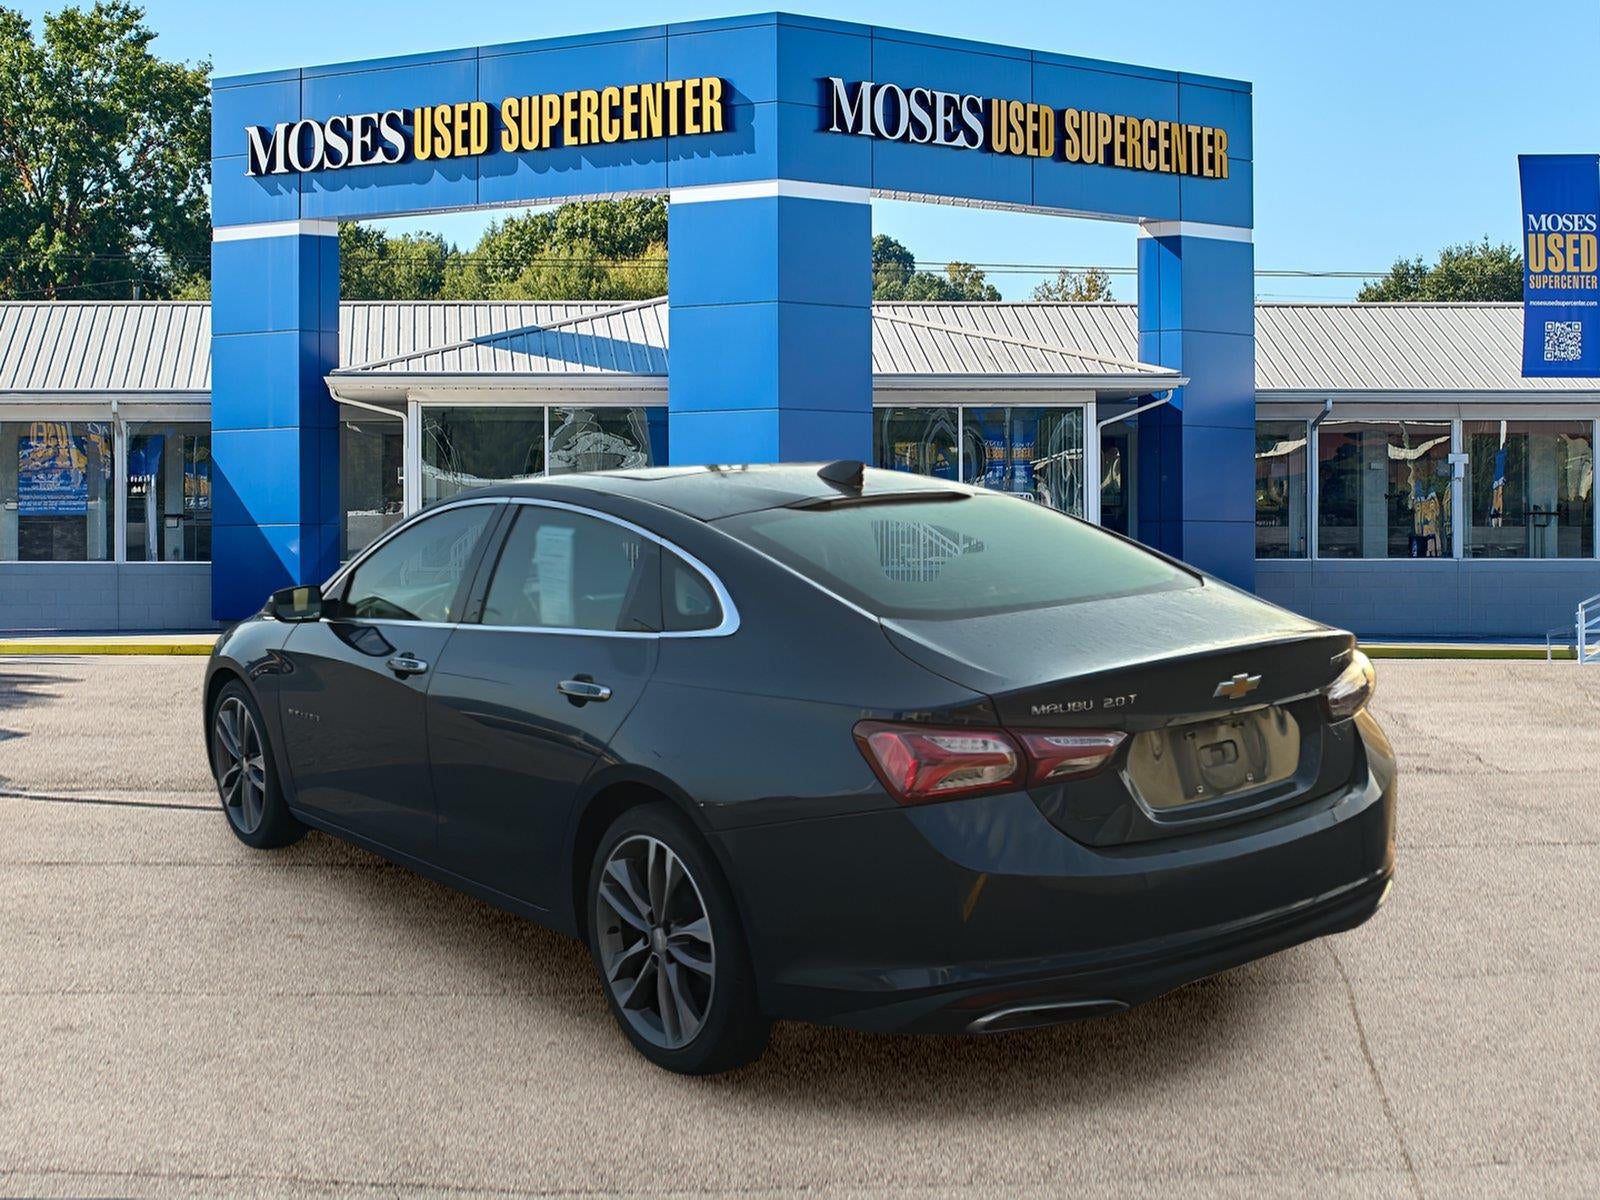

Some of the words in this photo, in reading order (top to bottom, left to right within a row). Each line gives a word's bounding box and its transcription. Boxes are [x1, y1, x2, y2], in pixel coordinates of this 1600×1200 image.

[245, 110, 406, 176] MOSES
[413, 101, 488, 160] USED
[501, 77, 723, 154] SUPERCENTER
[829, 77, 984, 149] MOSES
[991, 98, 1055, 158] USED
[1064, 108, 1229, 179] SUPERCENTER
[1527, 213, 1597, 232] MOSES
[1528, 233, 1598, 273] USED
[1529, 274, 1598, 290] SUPERCENTER
[1031, 700, 1094, 715] MALIBU
